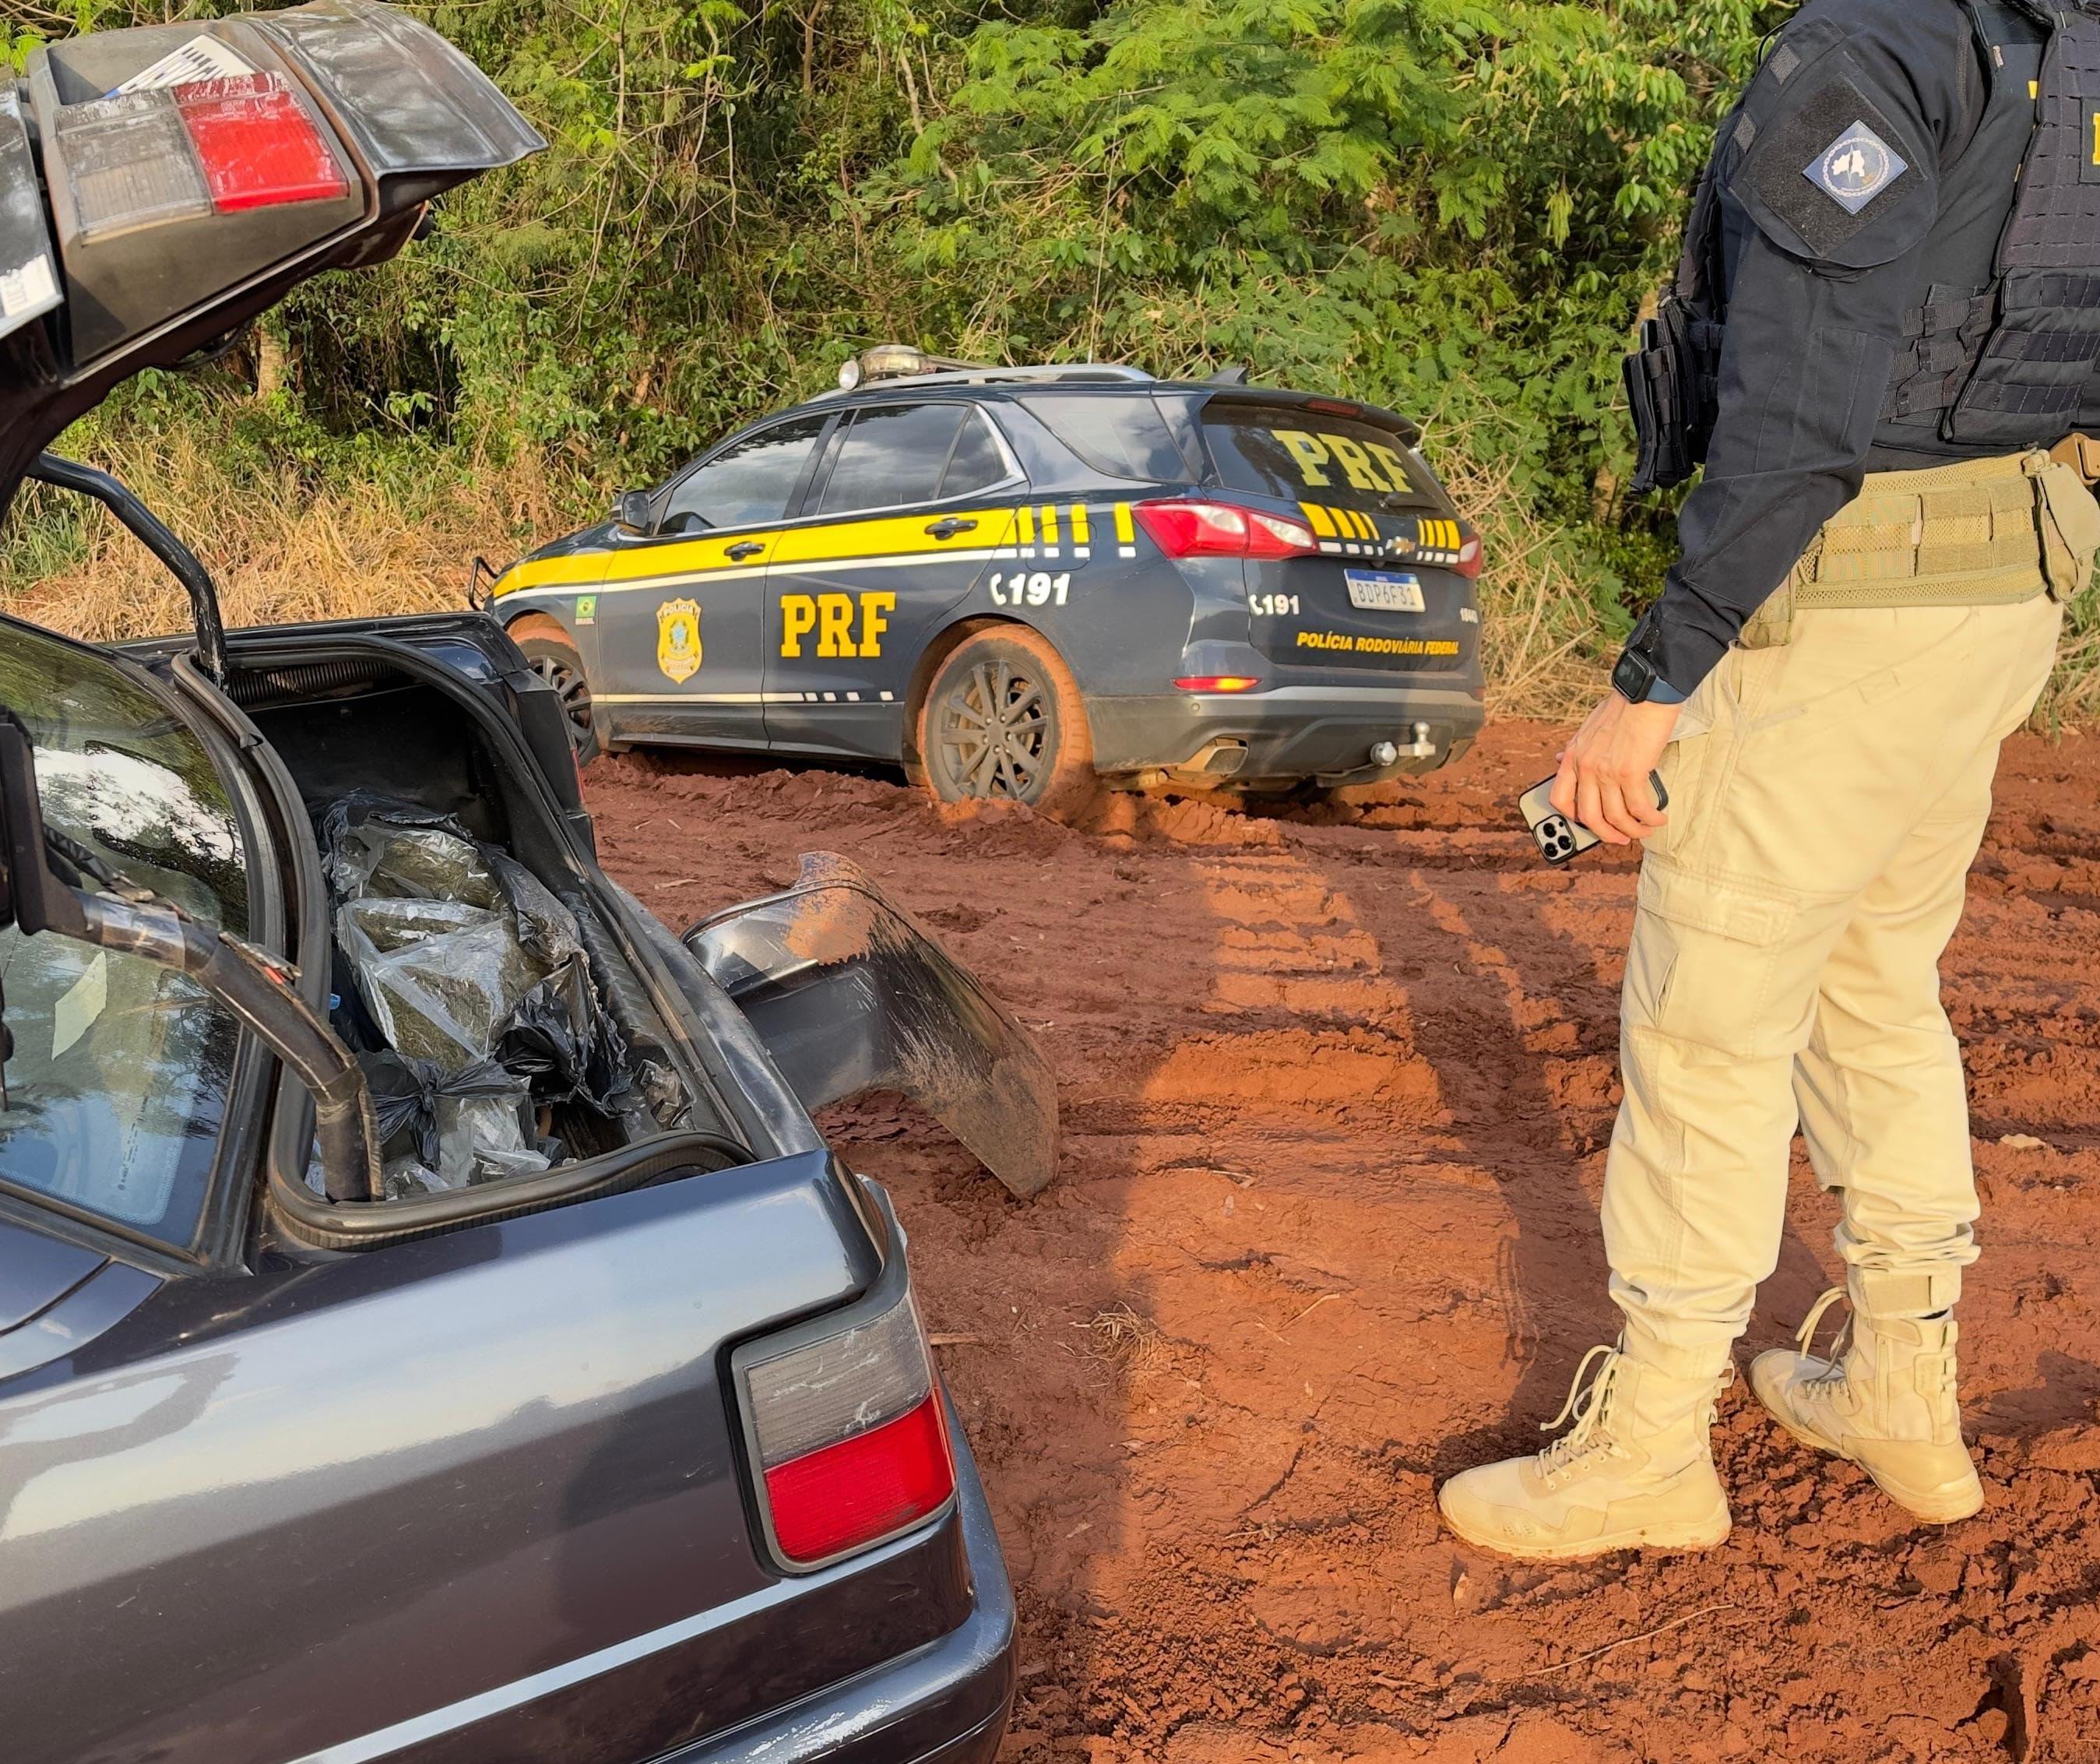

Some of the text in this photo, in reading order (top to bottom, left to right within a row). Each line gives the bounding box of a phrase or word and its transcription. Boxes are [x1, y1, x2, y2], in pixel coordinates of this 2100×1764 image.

[1270, 430, 1413, 493] PRF
[1008, 572, 1071, 605] 191
[1356, 583, 1416, 606] BDP6F31
[1262, 594, 1300, 615] 191
[781, 592, 896, 657] PRF
[1296, 631, 1459, 655] POLÍCIA RODOVIÁRIA FEDERAL
